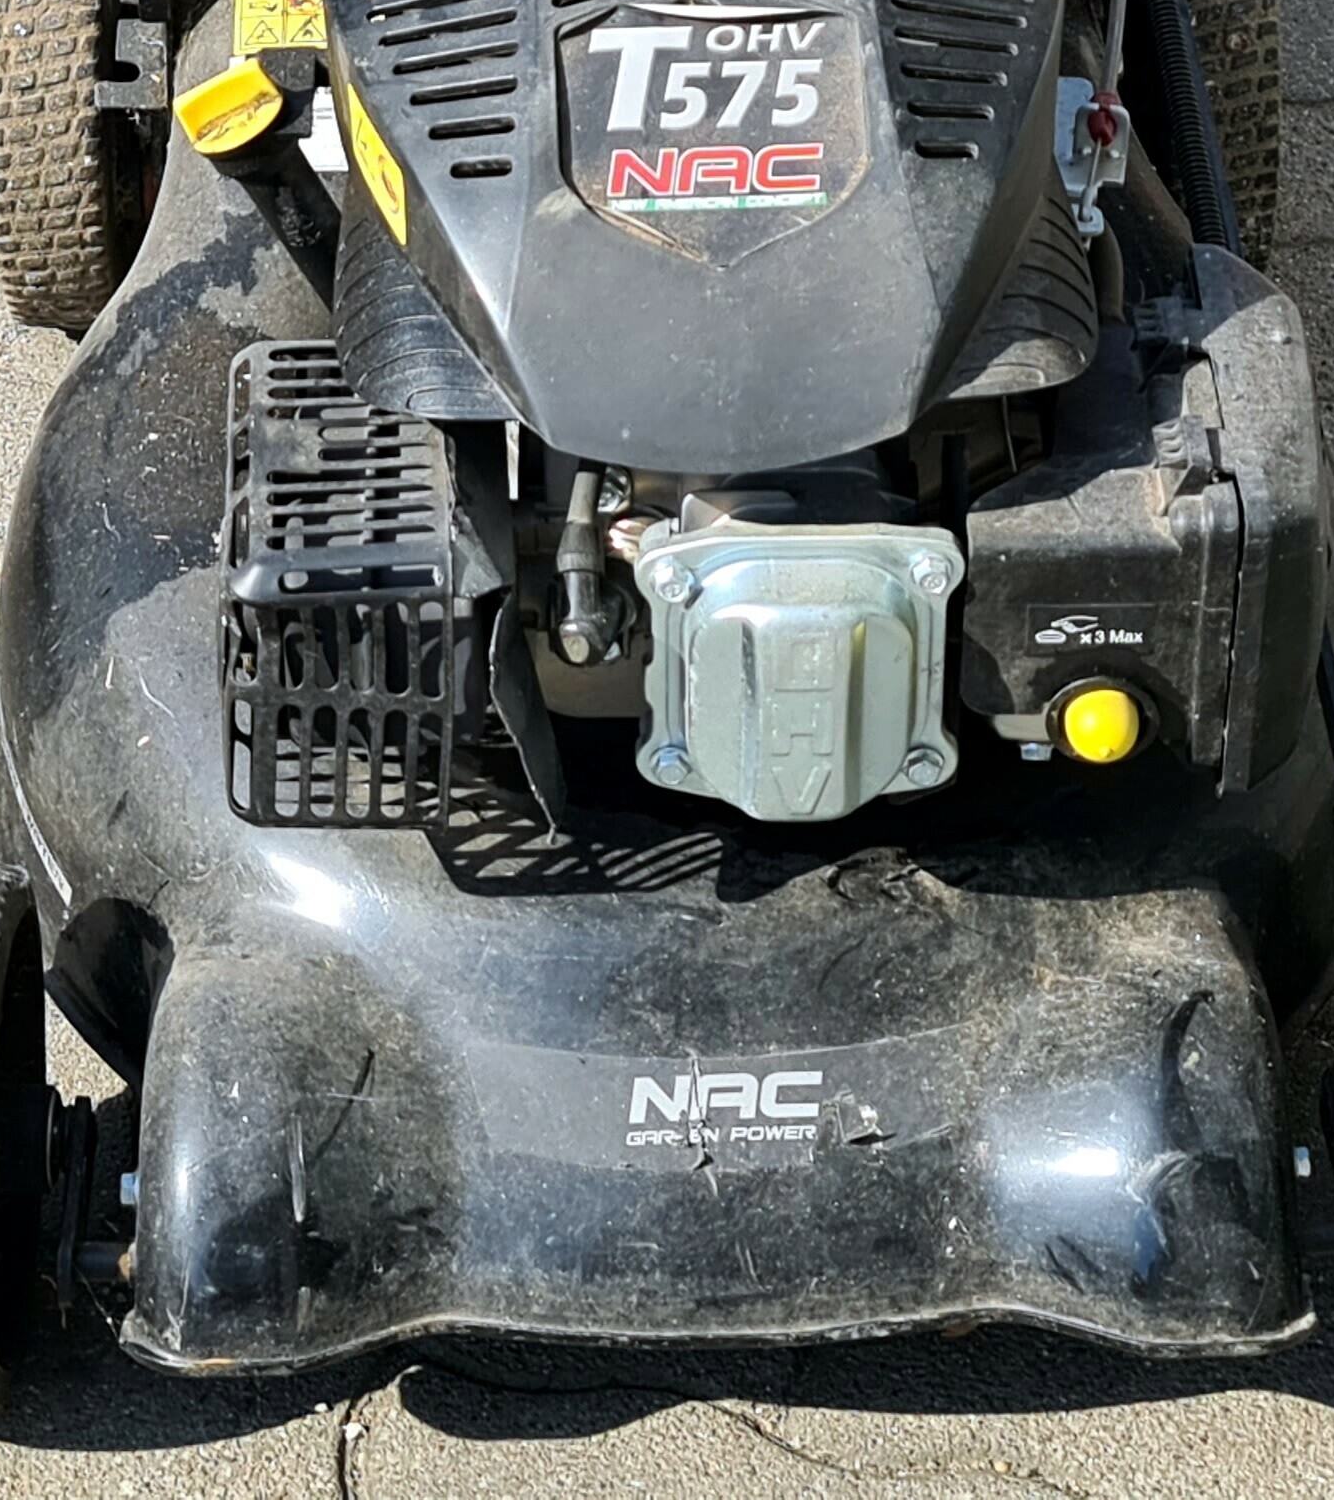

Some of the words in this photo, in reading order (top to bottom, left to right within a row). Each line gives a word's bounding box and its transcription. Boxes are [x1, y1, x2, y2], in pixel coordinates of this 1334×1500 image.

[705, 22, 825, 53] OHV
[606, 142, 824, 197] NAC
[1109, 629, 1143, 643] Max
[770, 631, 838, 816] OHV
[629, 1071, 823, 1124] NAC
[729, 1125, 816, 1142] POWER
